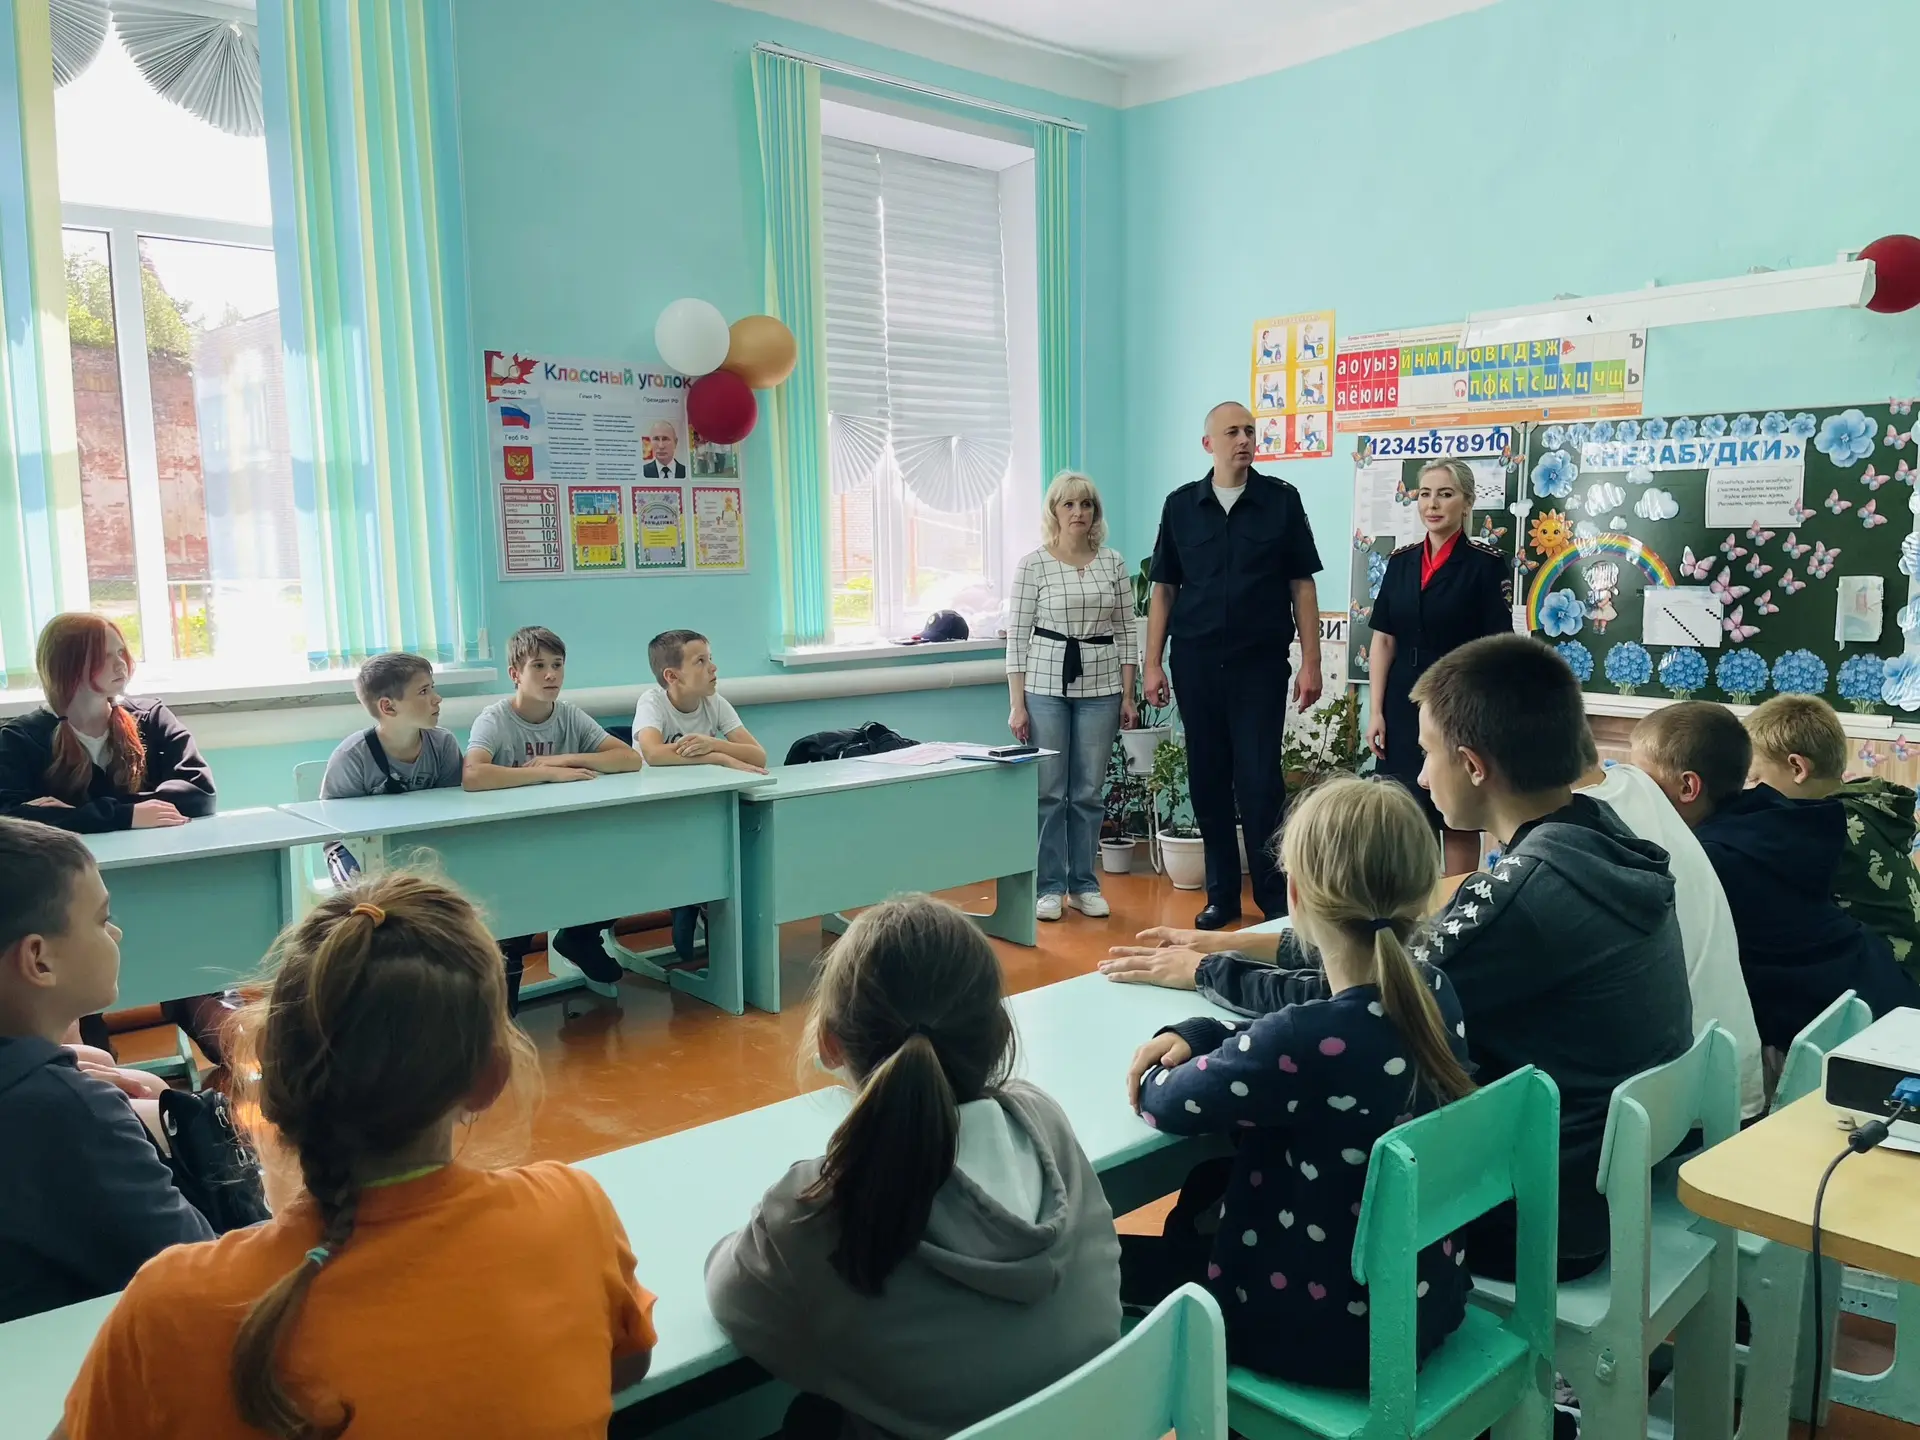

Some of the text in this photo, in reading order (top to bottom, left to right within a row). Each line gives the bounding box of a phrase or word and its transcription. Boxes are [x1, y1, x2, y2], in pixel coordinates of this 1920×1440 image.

[544, 362, 693, 390] Классный уголок
[1585, 439, 1802, 467] «НЕЗАБУДКИ»
[540, 503, 556, 515] 101
[540, 516, 557, 528] 102
[541, 530, 557, 541] 103
[542, 543, 559, 555] 104
[543, 556, 560, 568] 112
